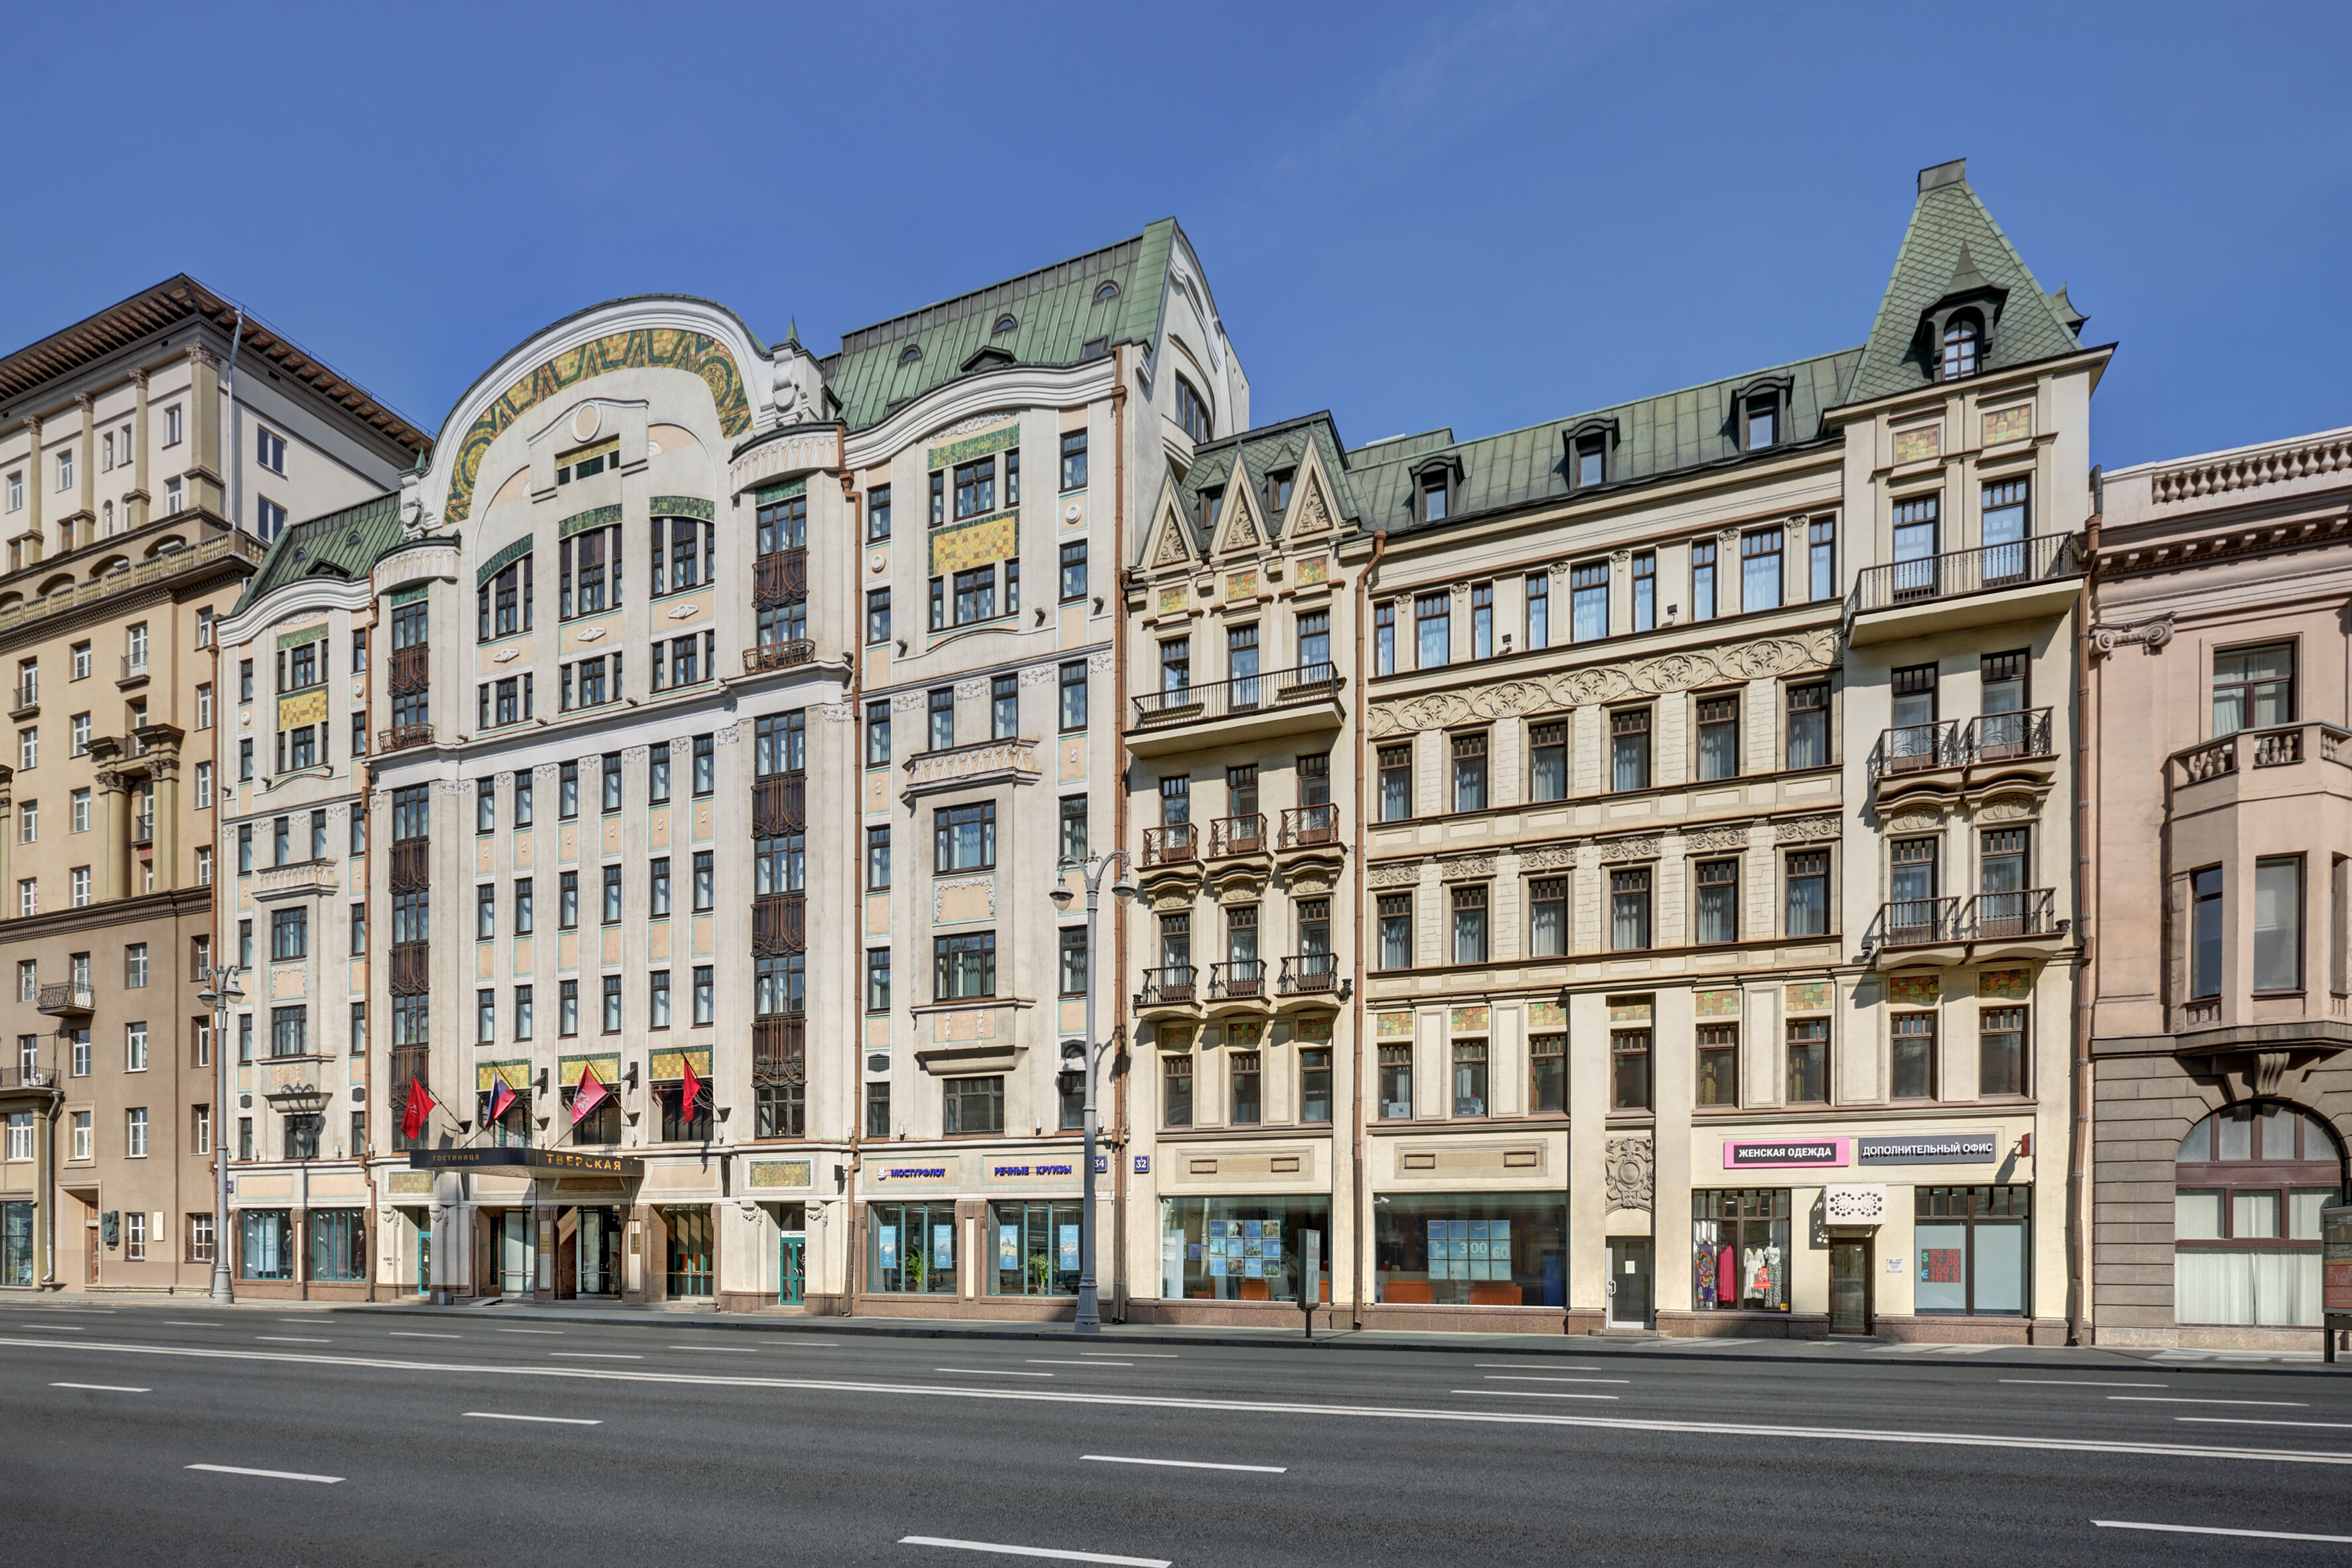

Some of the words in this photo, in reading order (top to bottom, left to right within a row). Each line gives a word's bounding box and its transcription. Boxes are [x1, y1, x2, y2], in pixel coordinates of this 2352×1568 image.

[1739, 1148, 1785, 1157] ЖЕНСКАЯ
[1788, 1147, 1832, 1158] ОДЕЖДА
[1863, 1142, 1960, 1156] ДОПОЛНИТЕЛЬНЫЙ
[1962, 1143, 1993, 1152] ОФИС
[546, 1154, 621, 1170] ТВЕРСКАЯ
[1095, 1159, 1105, 1168] 34
[1136, 1160, 1146, 1168] 32
[891, 1168, 945, 1178] МОСТУРФЛОТ
[994, 1166, 1029, 1176] РЕЧНЫЕ
[1036, 1165, 1071, 1174] КРУИЗЫ
[1922, 1252, 1928, 1263] $
[1930, 1249, 1960, 1258] 90.50
[1921, 1269, 1928, 1279] €
[1930, 1266, 1960, 1275] 100.0
